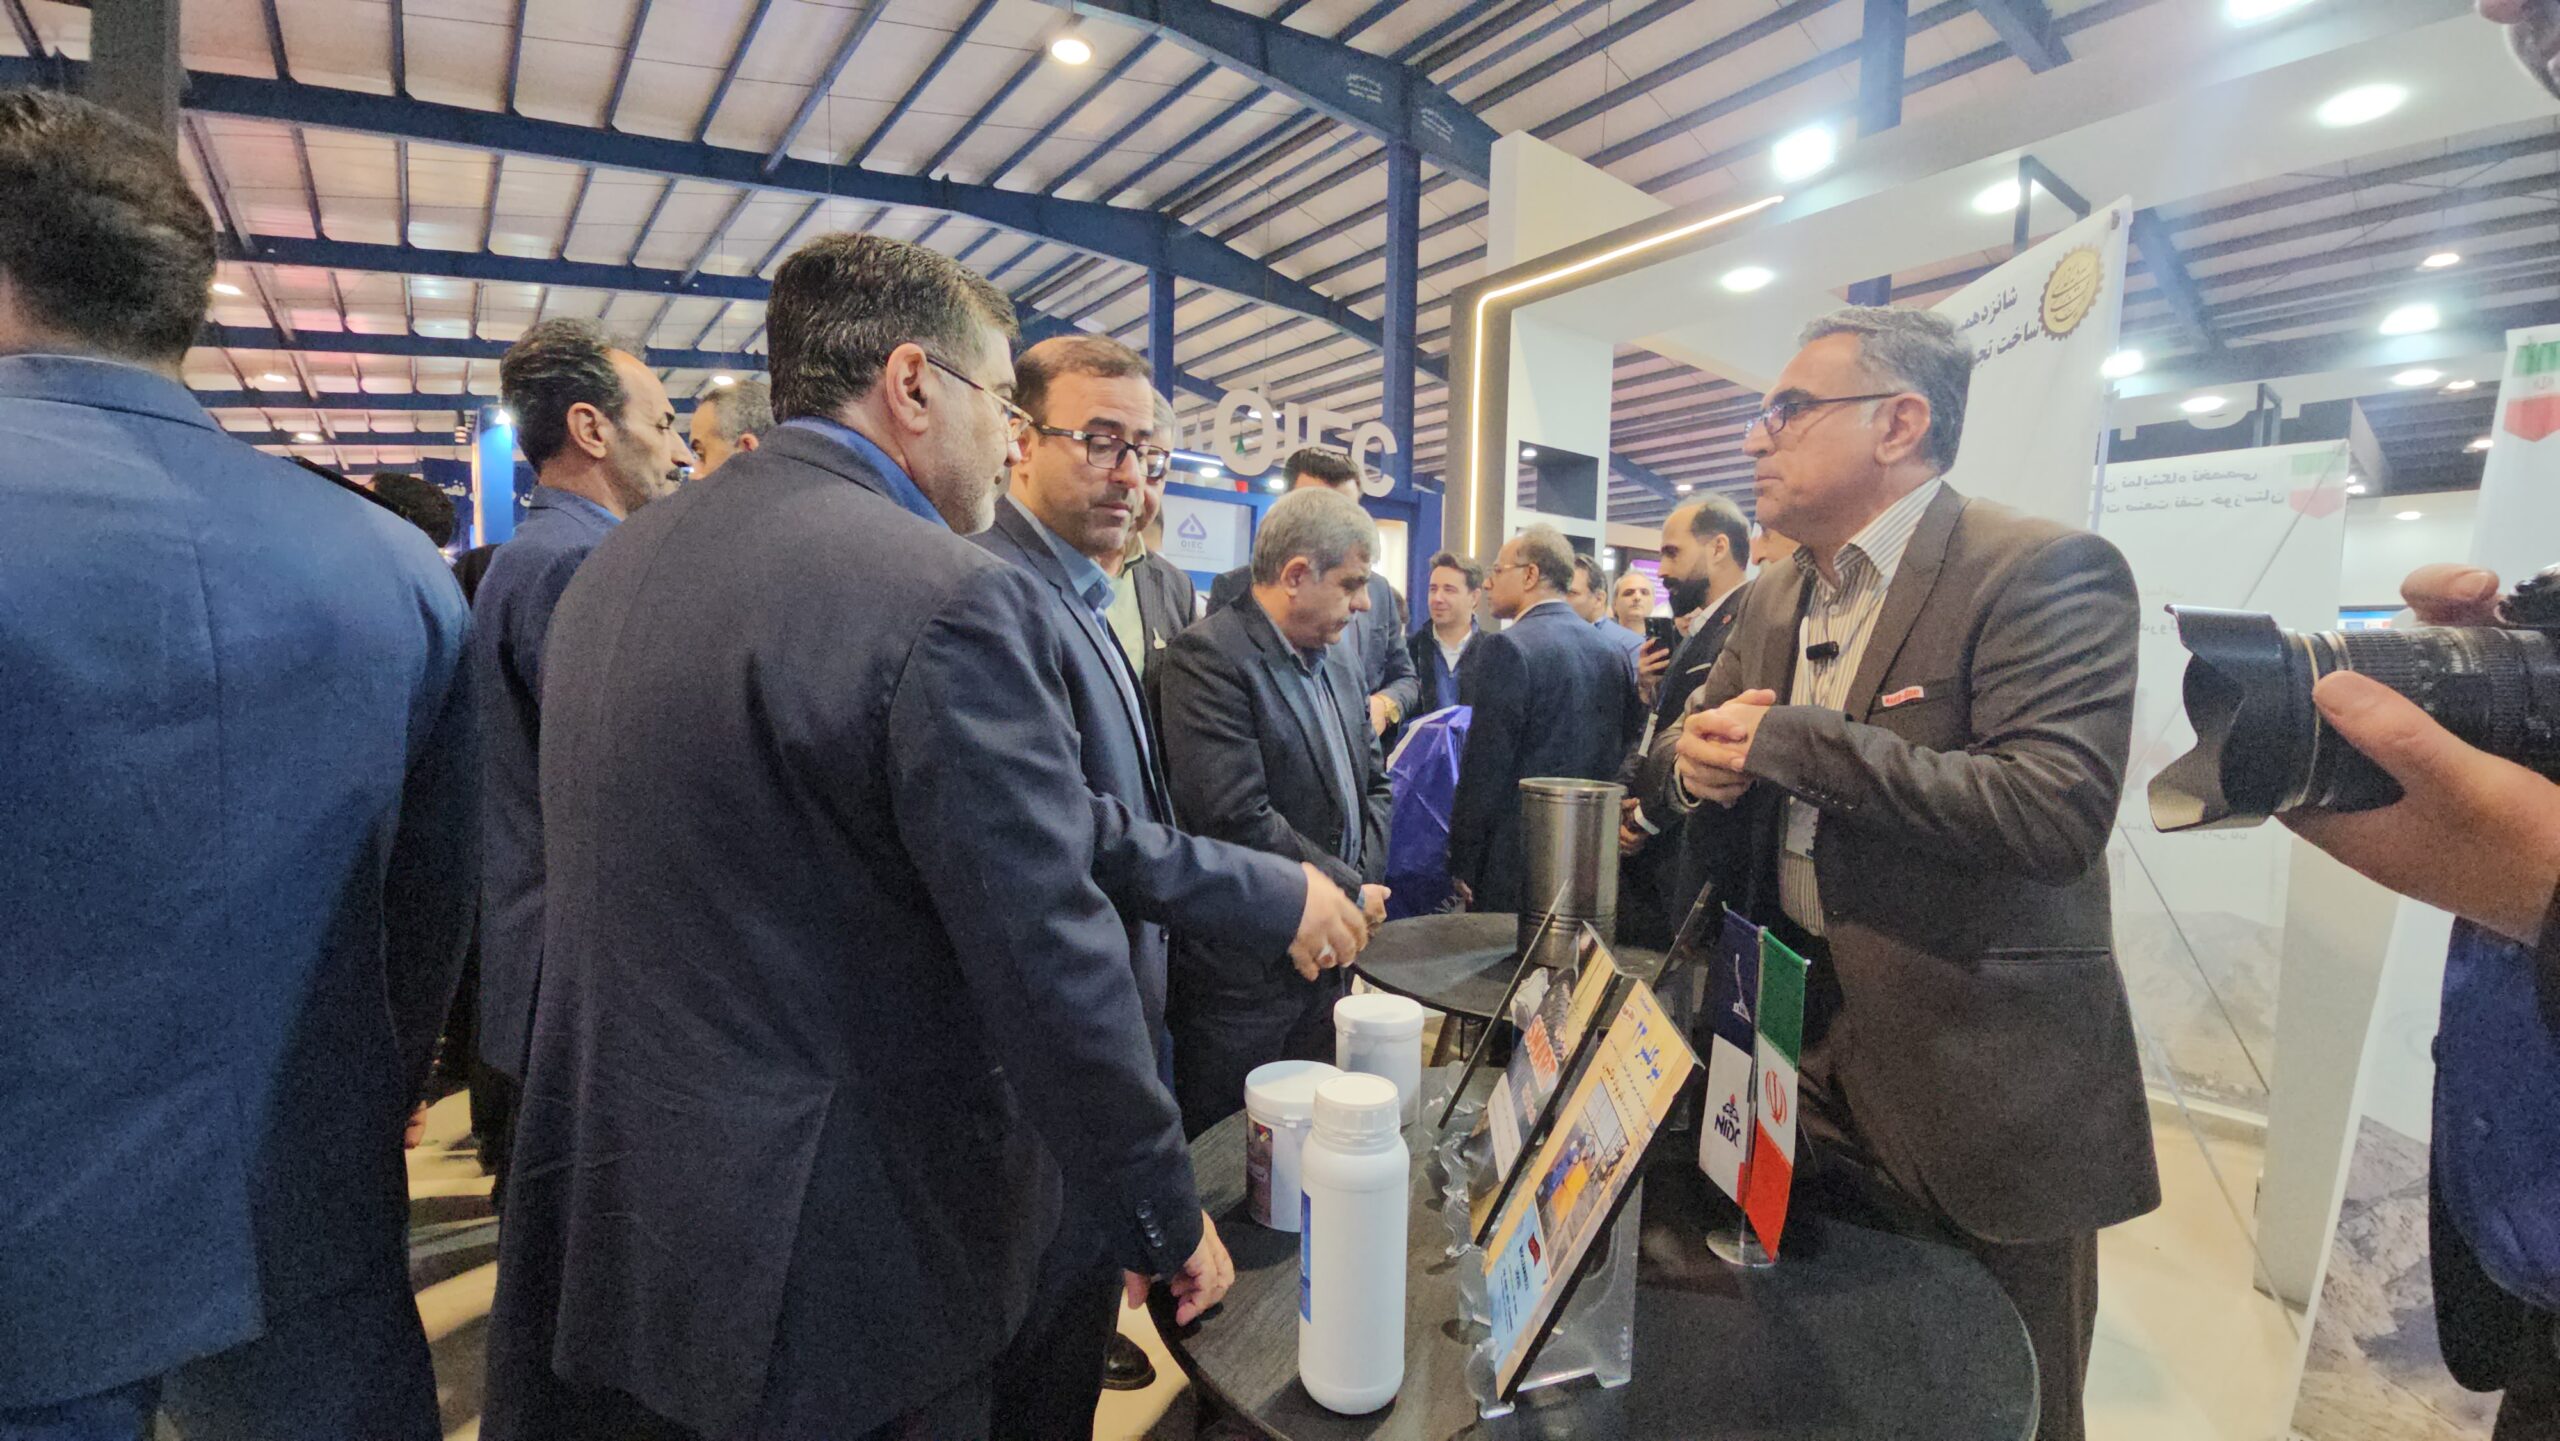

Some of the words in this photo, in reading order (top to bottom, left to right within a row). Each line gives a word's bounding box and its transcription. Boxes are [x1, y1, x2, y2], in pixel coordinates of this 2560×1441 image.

[1957, 286, 2018, 332] شانزدهم
[1997, 321, 2039, 355] ساخت
[1714, 1113, 1741, 1148] NIDC
